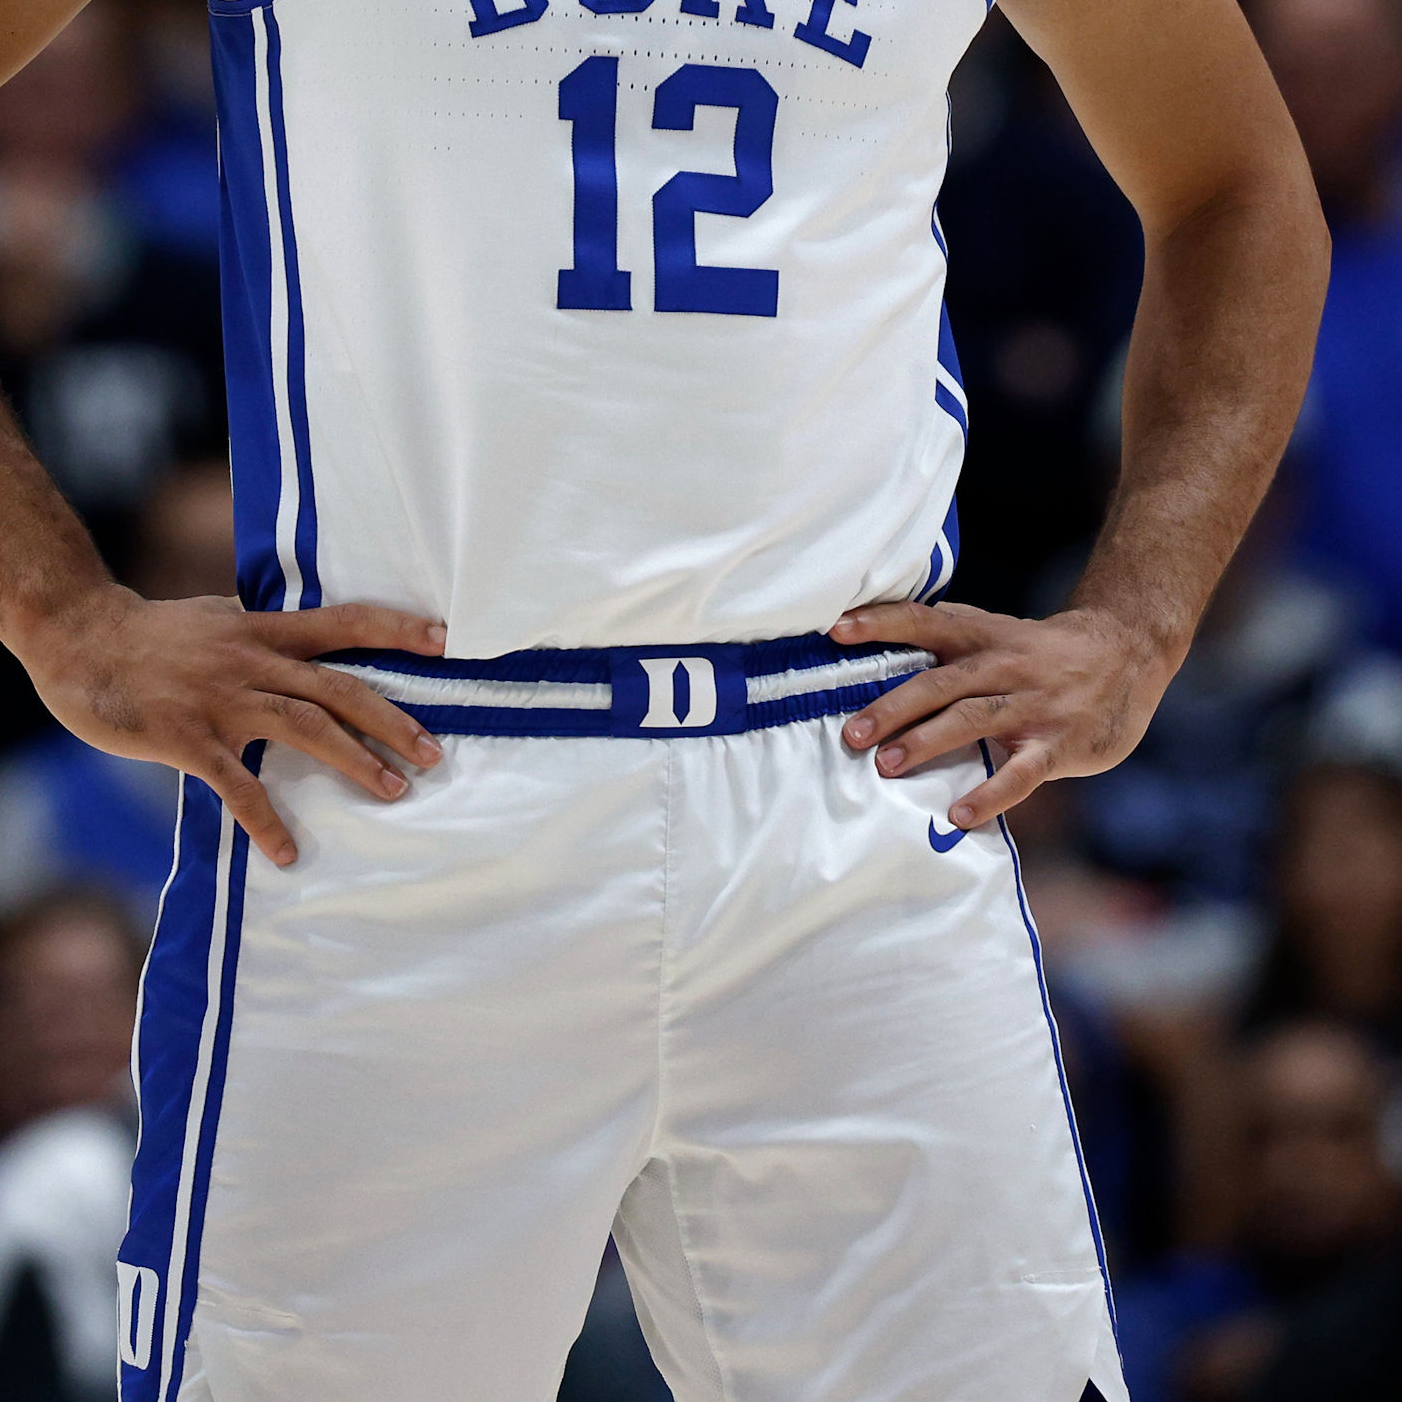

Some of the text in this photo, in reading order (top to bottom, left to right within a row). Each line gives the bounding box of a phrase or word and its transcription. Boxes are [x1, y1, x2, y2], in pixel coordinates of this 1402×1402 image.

[557, 54, 780, 318] 12
[638, 656, 718, 729] D
[116, 1260, 160, 1371] D
